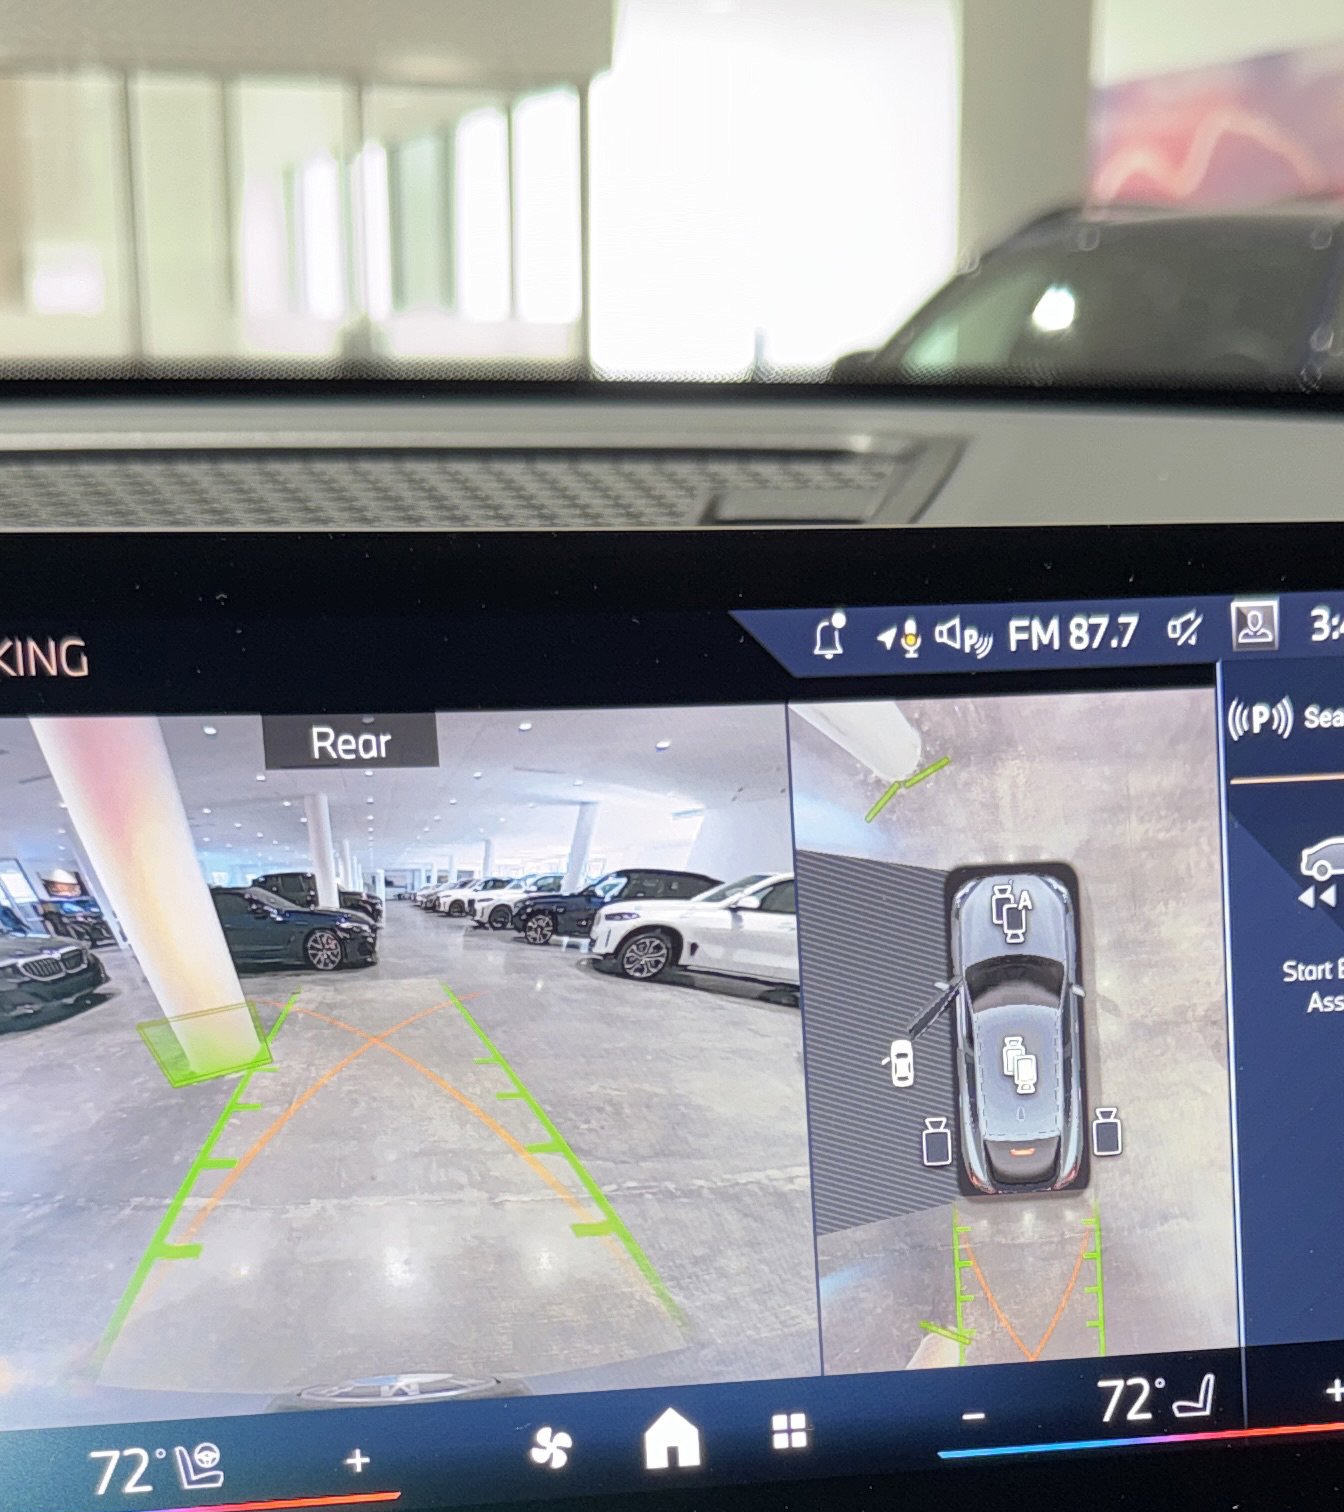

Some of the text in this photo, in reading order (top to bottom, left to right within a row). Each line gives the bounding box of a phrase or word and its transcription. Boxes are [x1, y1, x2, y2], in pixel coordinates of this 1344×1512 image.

[1009, 612, 1140, 652] FM 87.7
[312, 725, 392, 760] Rear
[1283, 959, 1334, 982] Start
